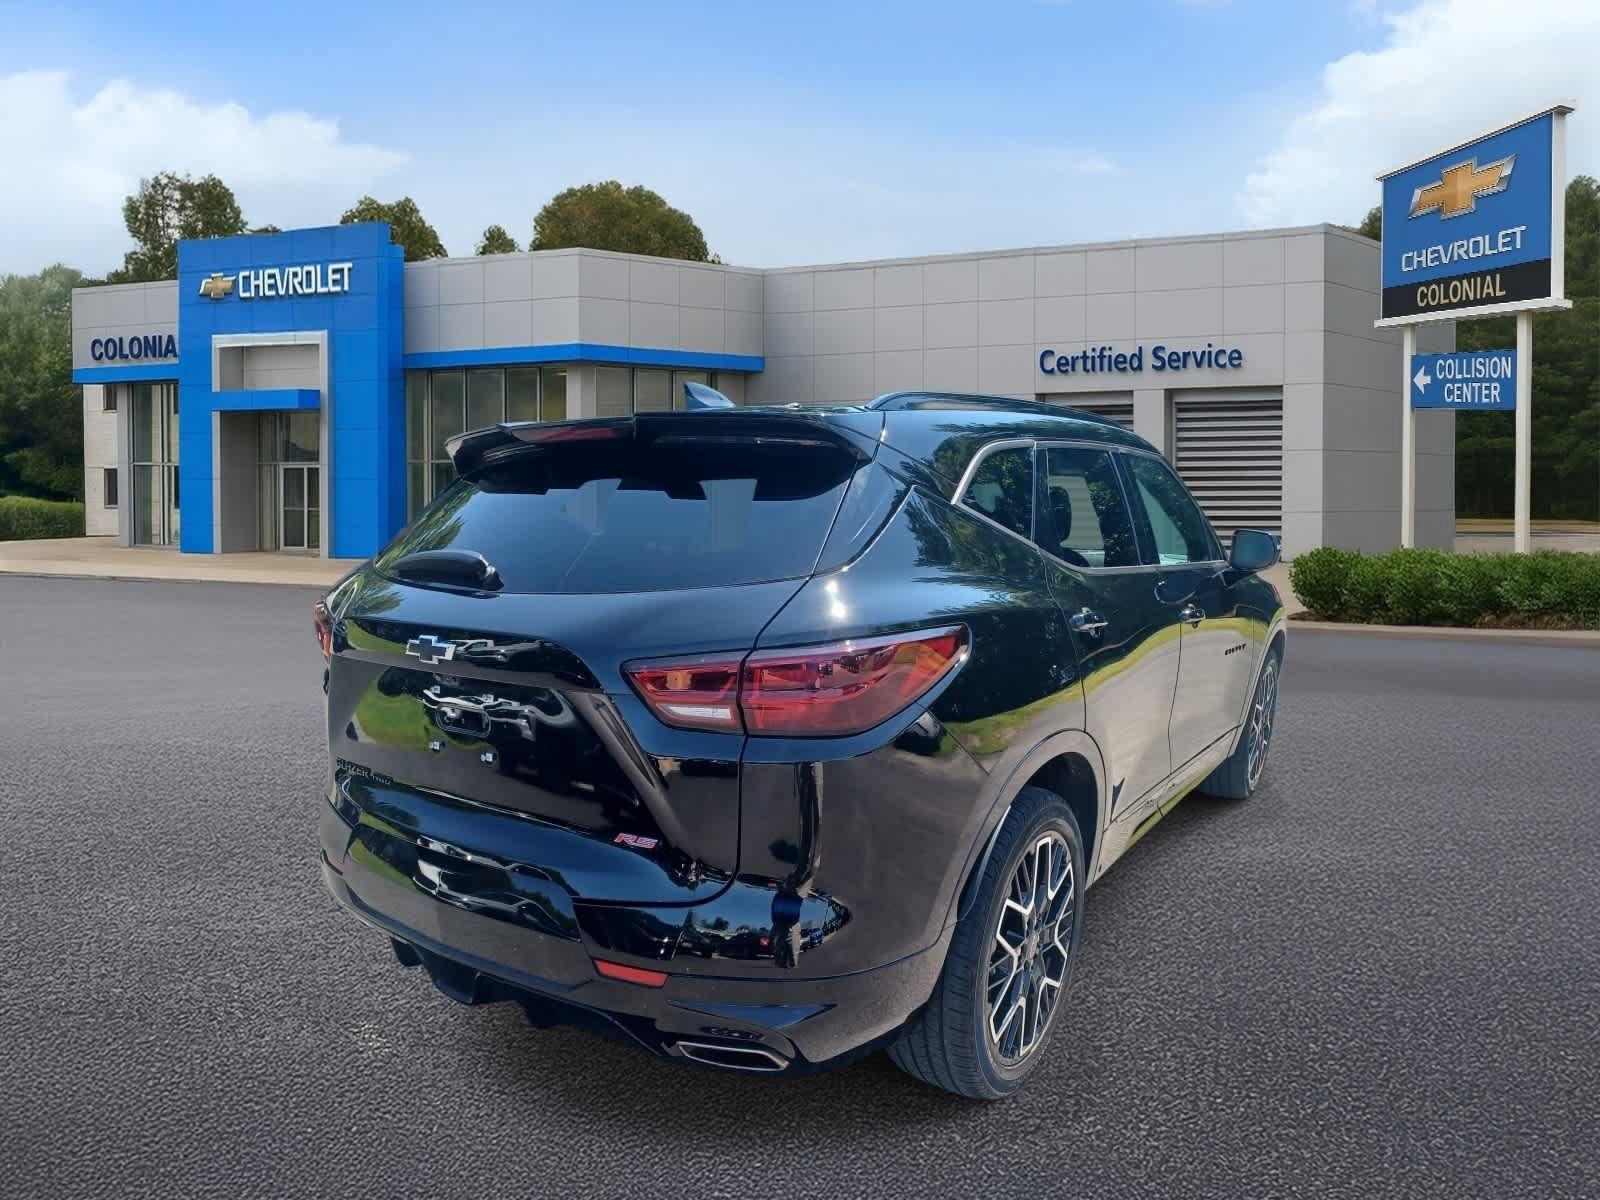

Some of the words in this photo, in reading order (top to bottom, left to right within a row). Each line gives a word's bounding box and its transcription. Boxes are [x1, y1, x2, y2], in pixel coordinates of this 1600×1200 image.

[1401, 225, 1528, 272] CHEVROLET
[238, 262, 353, 298] CHEVROLET
[1417, 274, 1507, 307] COLONIAL
[1039, 346, 1144, 375] Certified
[1151, 343, 1243, 371] Service
[1436, 356, 1512, 380] COLLISION
[1444, 382, 1501, 403] CENTER
[614, 832, 658, 849] RS
